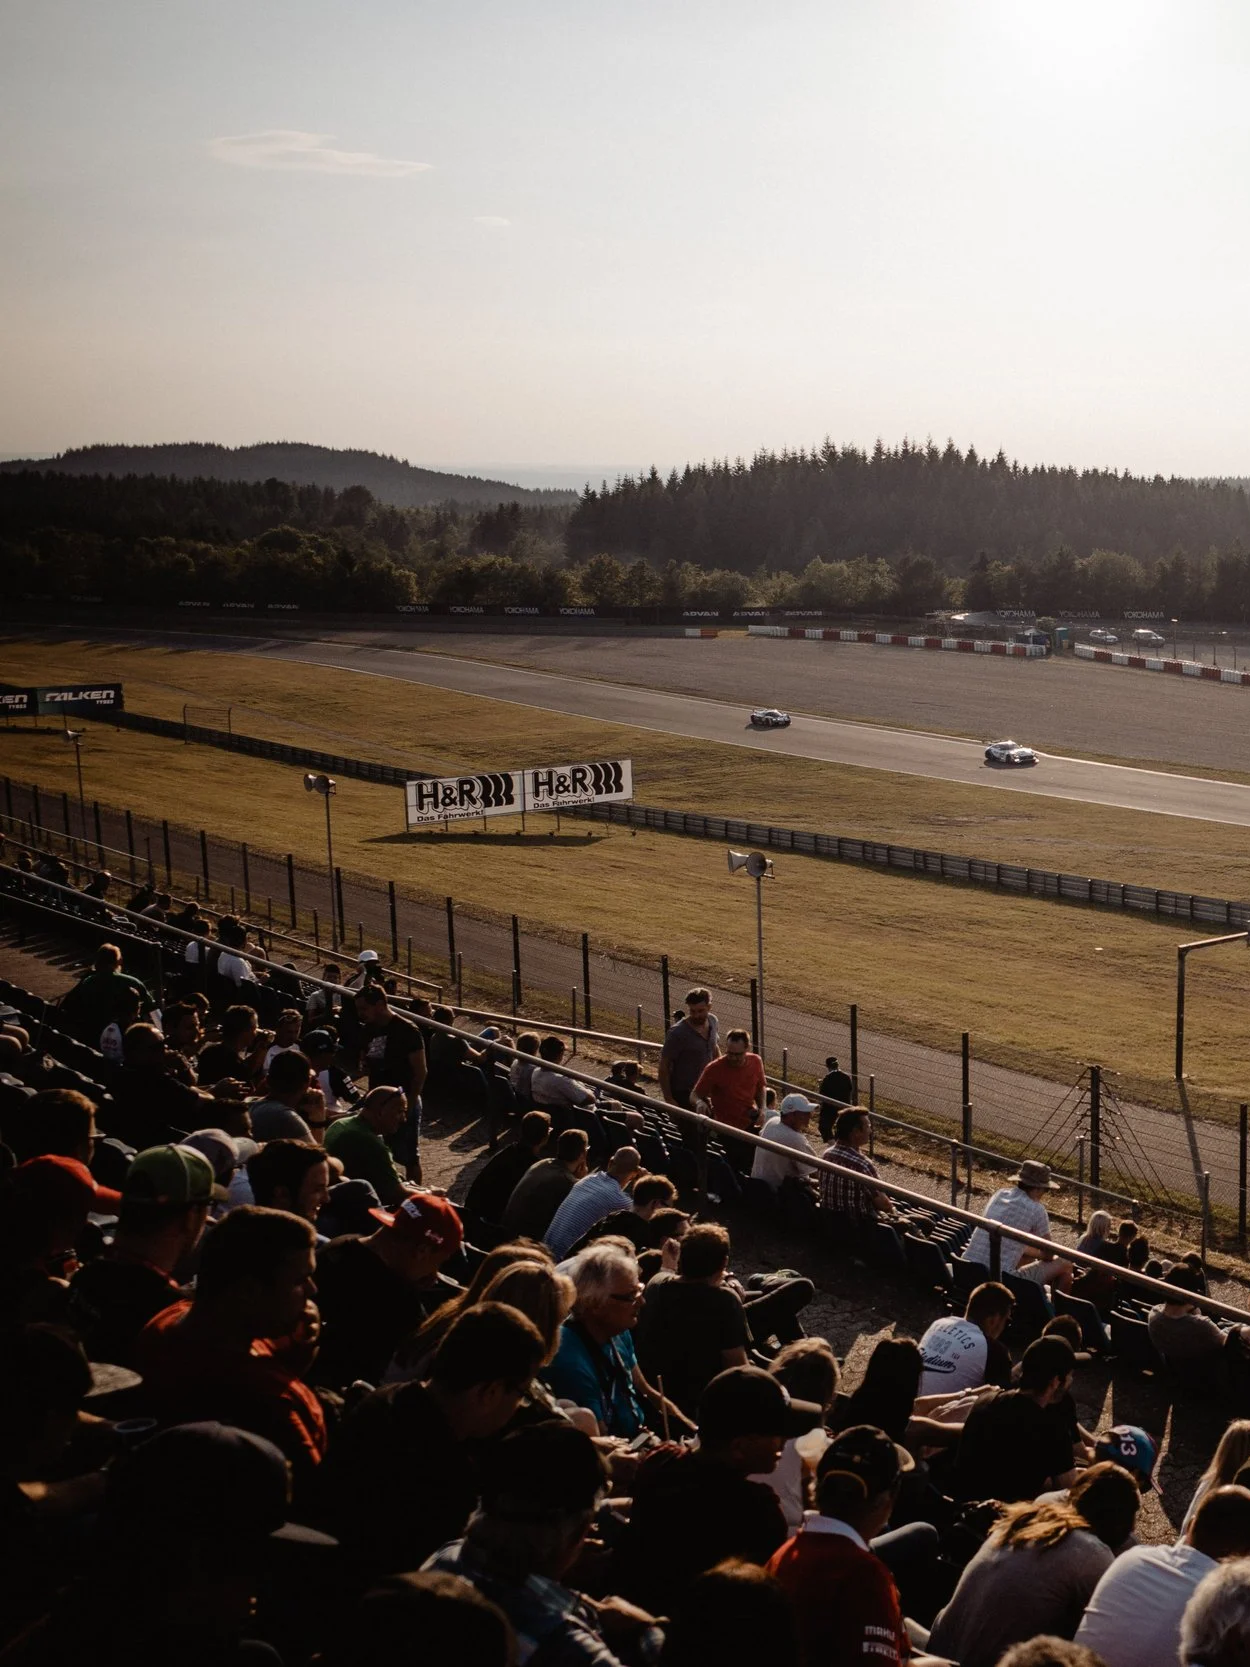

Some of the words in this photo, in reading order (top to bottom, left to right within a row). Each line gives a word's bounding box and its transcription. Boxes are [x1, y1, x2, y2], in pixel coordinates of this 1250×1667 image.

[449, 605, 484, 614] YOKOHAMA
[504, 606, 539, 615] YOKOHAMA
[559, 607, 595, 617] YOKOHAMA
[995, 609, 1036, 618] YOKOHAMA
[1059, 610, 1100, 618] YOKOHAMA
[1123, 611, 1165, 619] YOKOHAMA
[45, 690, 115, 701] FALKEN
[532, 767, 589, 799] H&R
[416, 779, 481, 813] H&R
[552, 797, 594, 807] Fahrwerk!
[437, 809, 484, 820] Fahrwerk!
